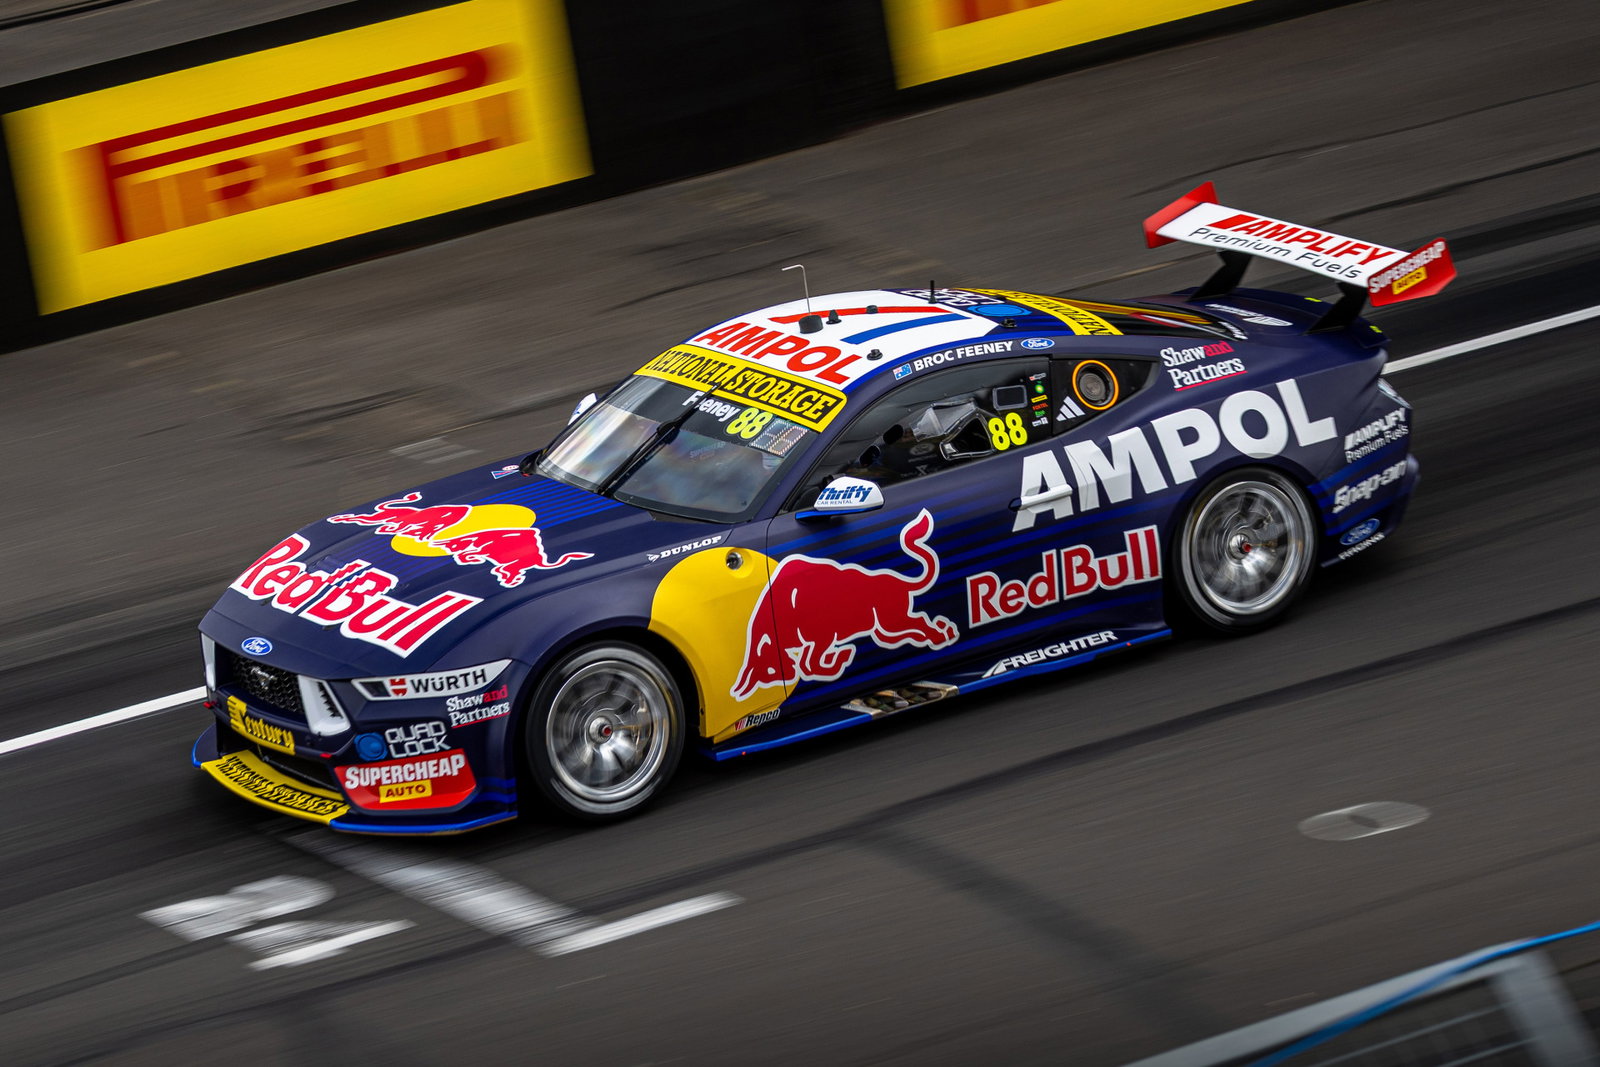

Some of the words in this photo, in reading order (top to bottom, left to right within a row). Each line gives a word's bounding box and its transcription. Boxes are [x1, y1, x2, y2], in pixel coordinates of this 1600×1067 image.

[1188, 227, 1291, 257] Premium
[1296, 252, 1363, 280] Fuels
[1238, 219, 1395, 266] AMPLIFY
[1369, 241, 1446, 293] SUPERCHEAP
[694, 322, 862, 384] AMPOL
[913, 350, 955, 372] BROC
[956, 340, 1014, 360] FEENEY
[1023, 338, 1053, 350] Ford
[646, 349, 735, 386] NATIONAL
[1167, 357, 1245, 389] Partners
[726, 369, 838, 420] STORAGE
[682, 390, 741, 422] Feney
[725, 407, 774, 439] 88
[988, 412, 1028, 450] 88
[1349, 407, 1407, 448] AMPLIFY
[1012, 378, 1338, 532] AMPOL
[1345, 436, 1386, 463] Premium
[1384, 424, 1409, 445] Fuels
[818, 485, 873, 502] Thrifty
[660, 535, 722, 559] DUNLOP
[1338, 532, 1385, 560] RACING
[228, 533, 371, 614] Red
[966, 549, 1059, 629] Red
[1061, 525, 1163, 600] Bull
[298, 567, 485, 659] Bull
[990, 629, 1119, 675] FREIGHTER
[385, 721, 446, 744] QUAD
[450, 702, 510, 728] Partners
[745, 708, 780, 728] Repco
[389, 735, 452, 759] LOCK
[345, 754, 466, 789] SUPERCHEAP
[385, 784, 426, 798] AUTO
